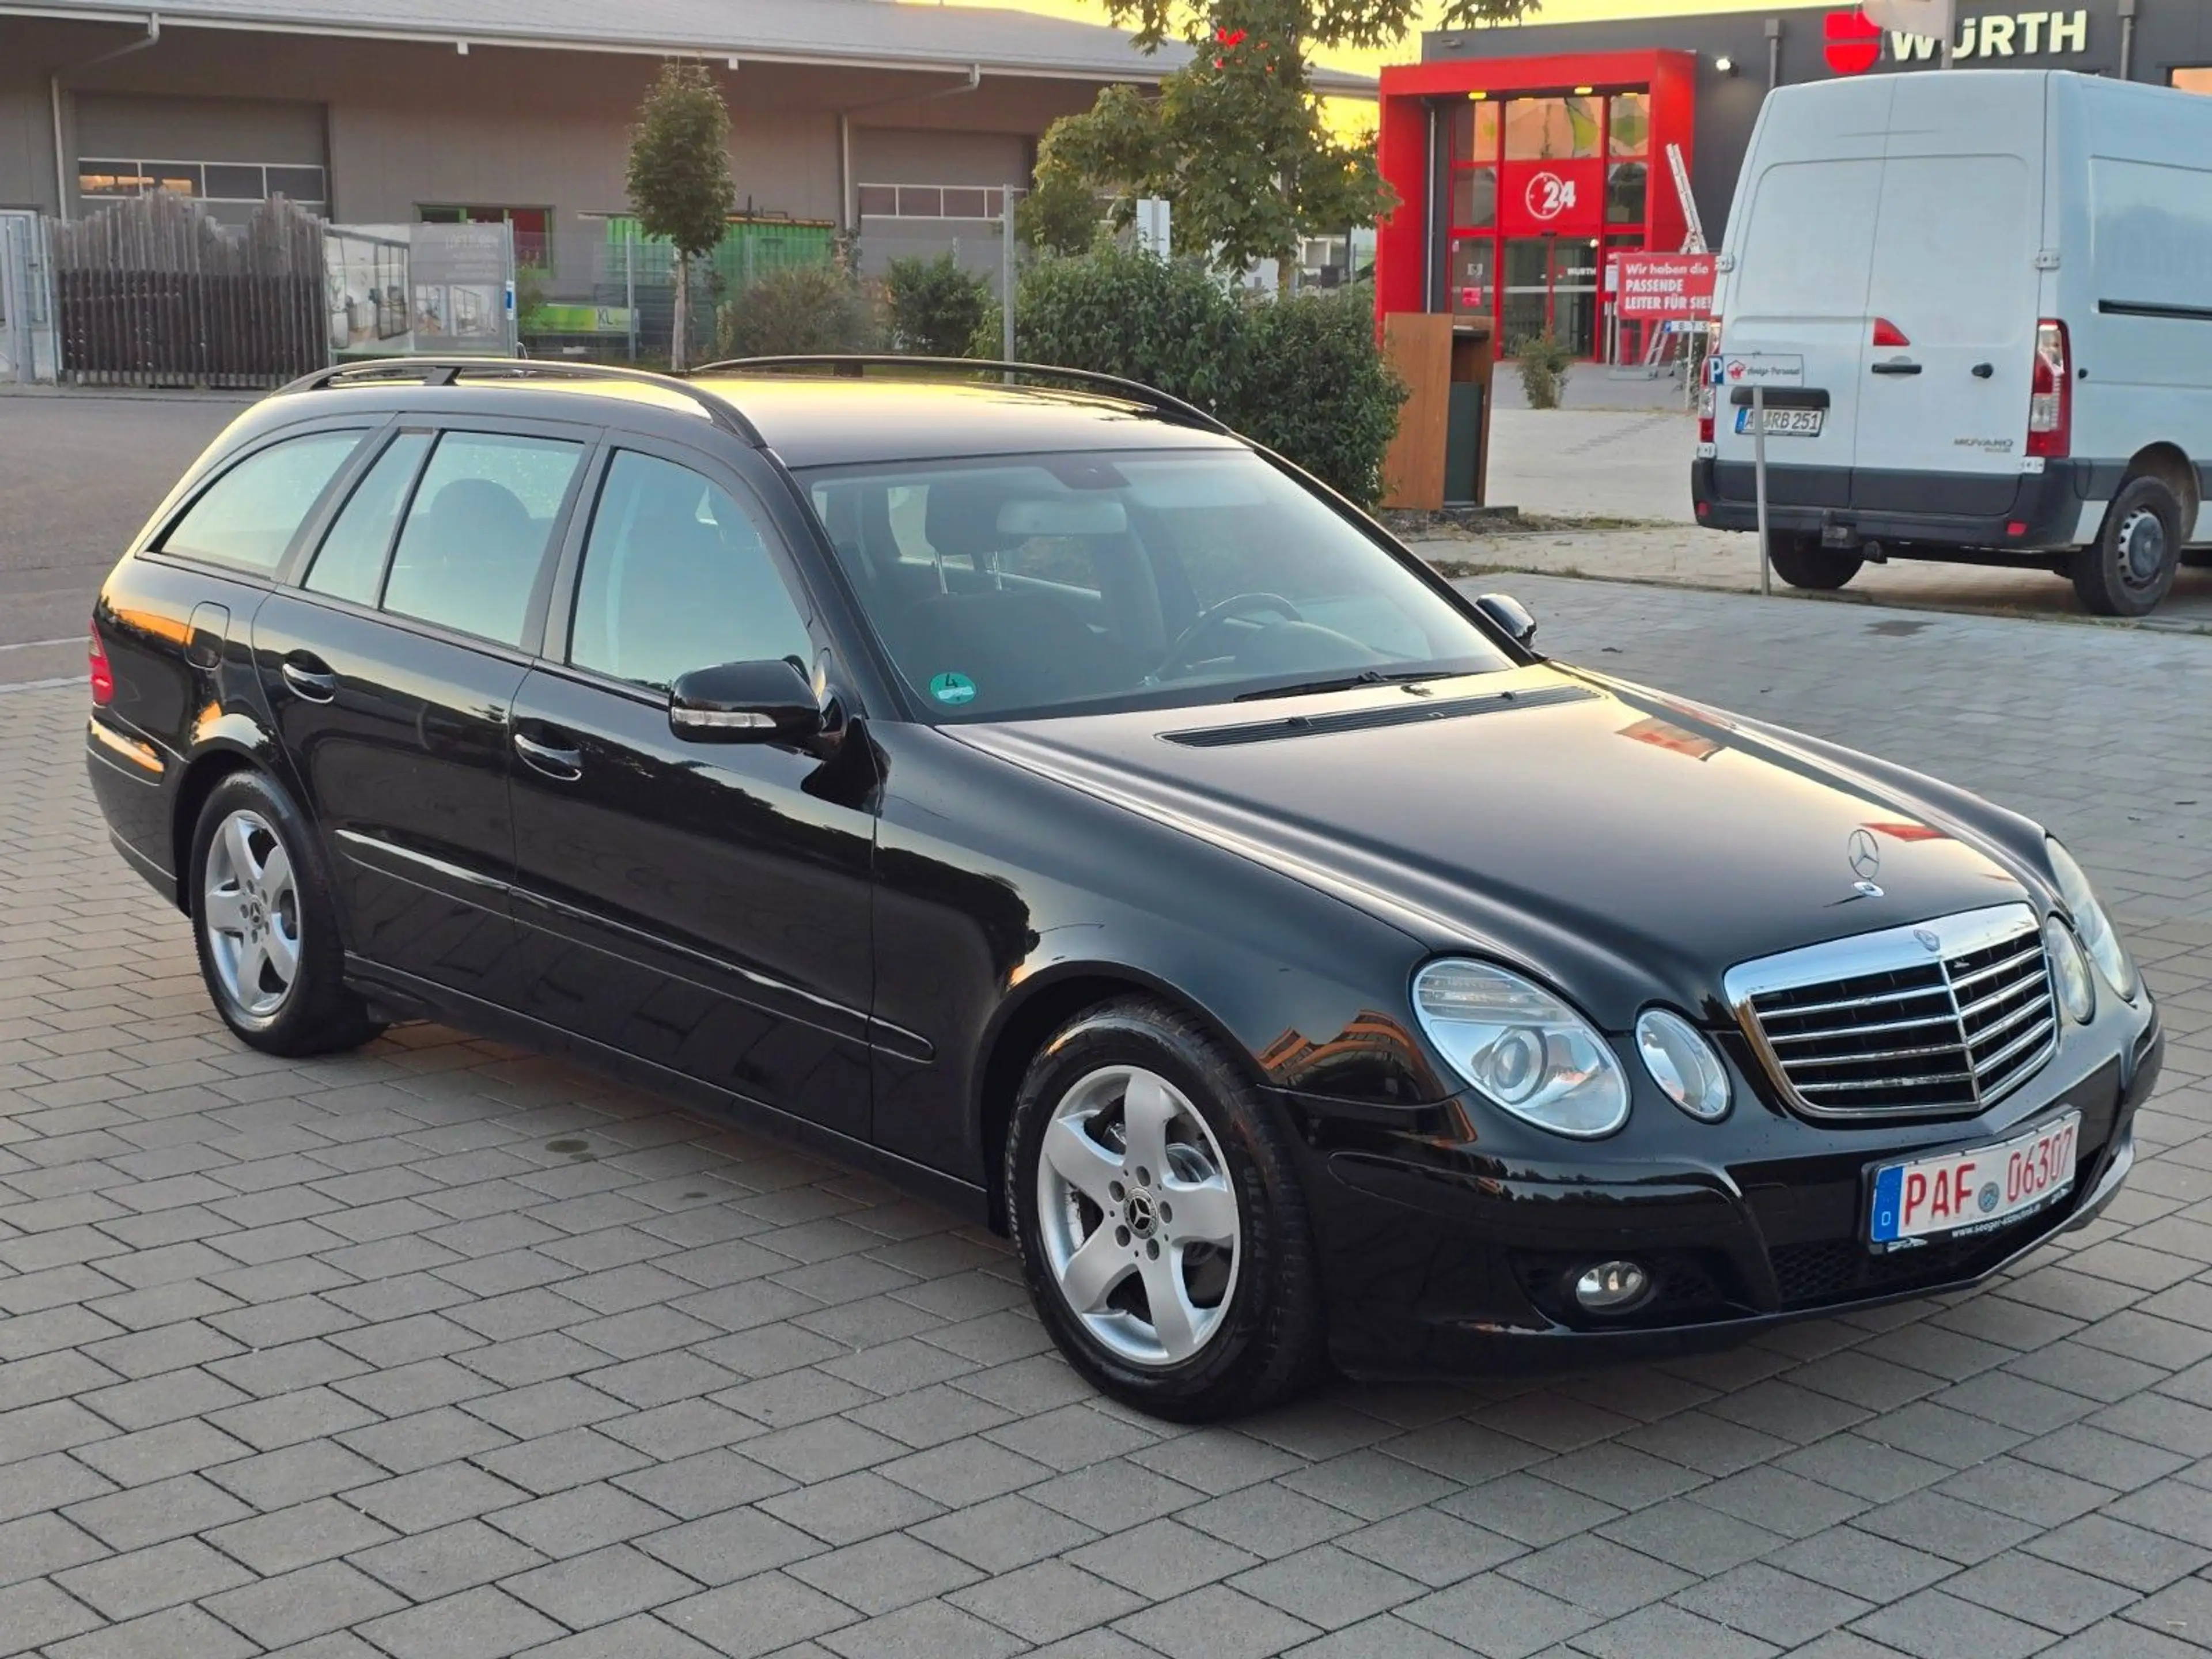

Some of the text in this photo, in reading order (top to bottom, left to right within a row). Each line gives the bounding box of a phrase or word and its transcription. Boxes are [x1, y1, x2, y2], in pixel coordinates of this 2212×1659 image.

[1543, 180, 1576, 209] 24
[1626, 262, 1709, 275] Wir haben die
[1625, 279, 1684, 292] PASSENDE
[1624, 296, 1661, 309] LEITER
[1664, 293, 1687, 310] FÜR
[1710, 358, 1723, 382] P
[1771, 412, 1791, 429] RB
[1791, 412, 1819, 430] 251
[1904, 1162, 1976, 1226] PAF
[2006, 1126, 2073, 1203] 06307
